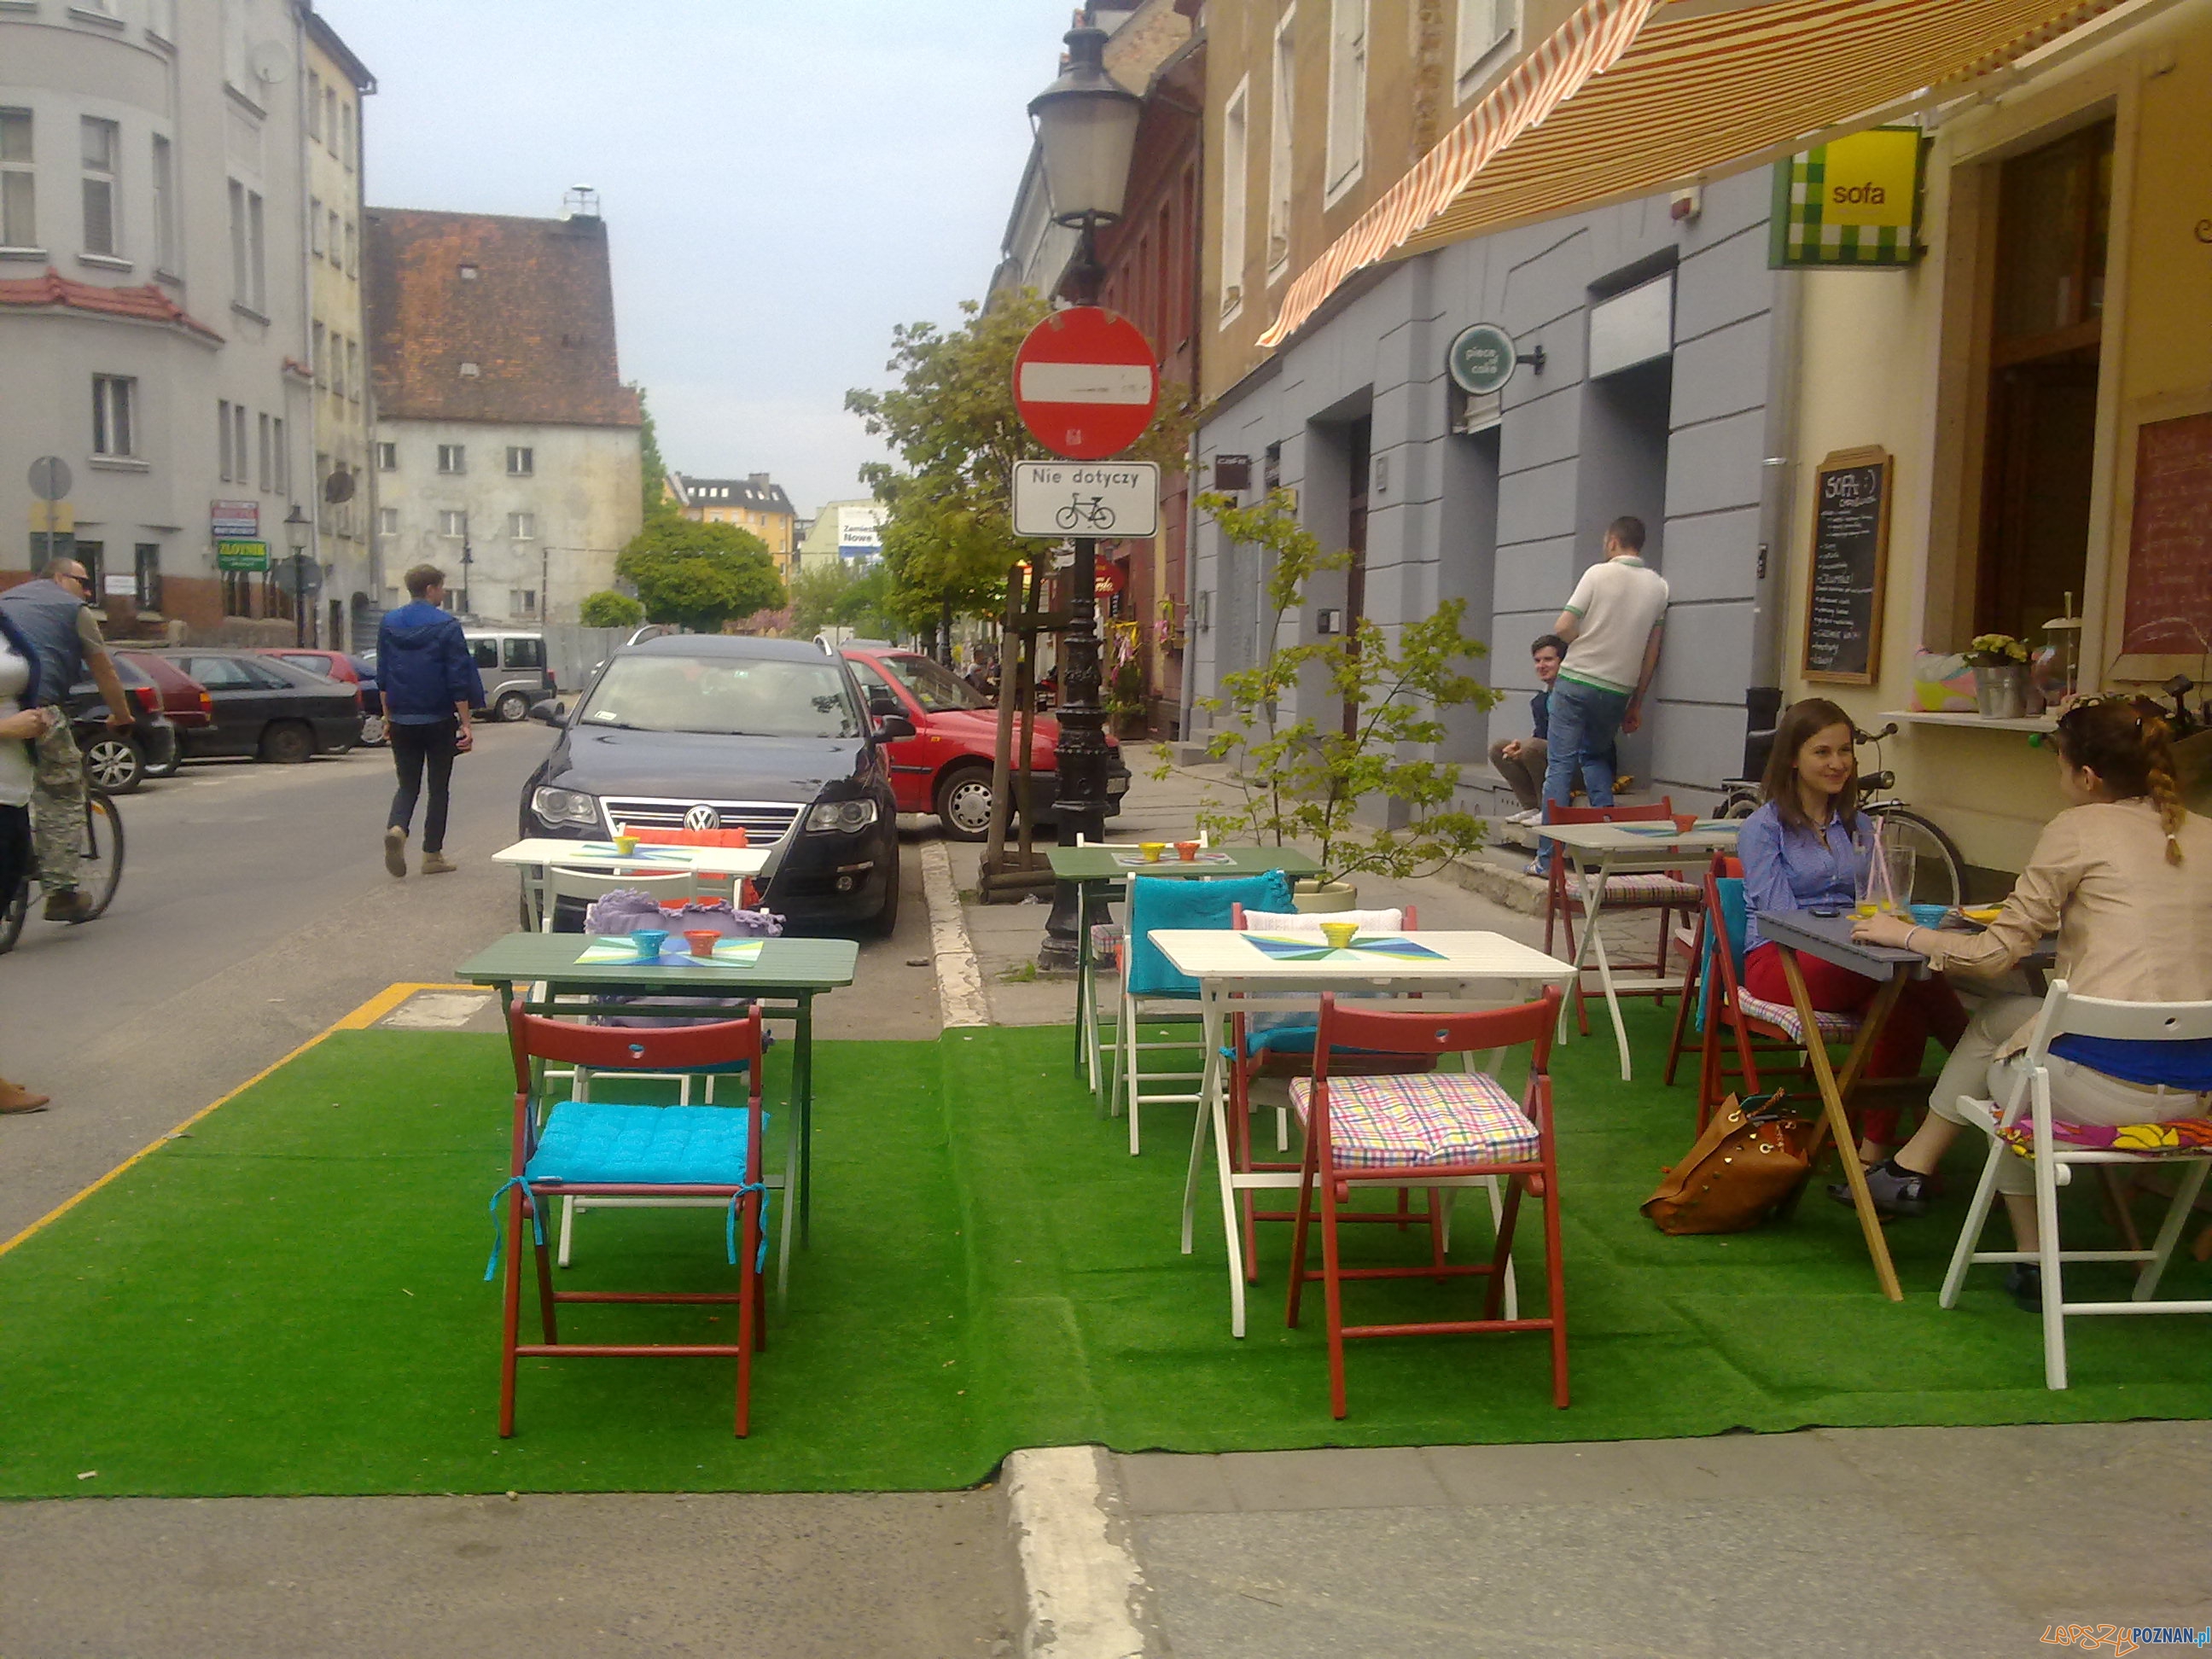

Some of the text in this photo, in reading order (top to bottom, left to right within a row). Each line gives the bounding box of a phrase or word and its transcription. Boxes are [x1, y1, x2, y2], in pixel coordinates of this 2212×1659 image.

[1832, 181, 1885, 205] sofa
[1033, 469, 1138, 489] Nie dotyczy
[843, 533, 872, 542] Nowe
